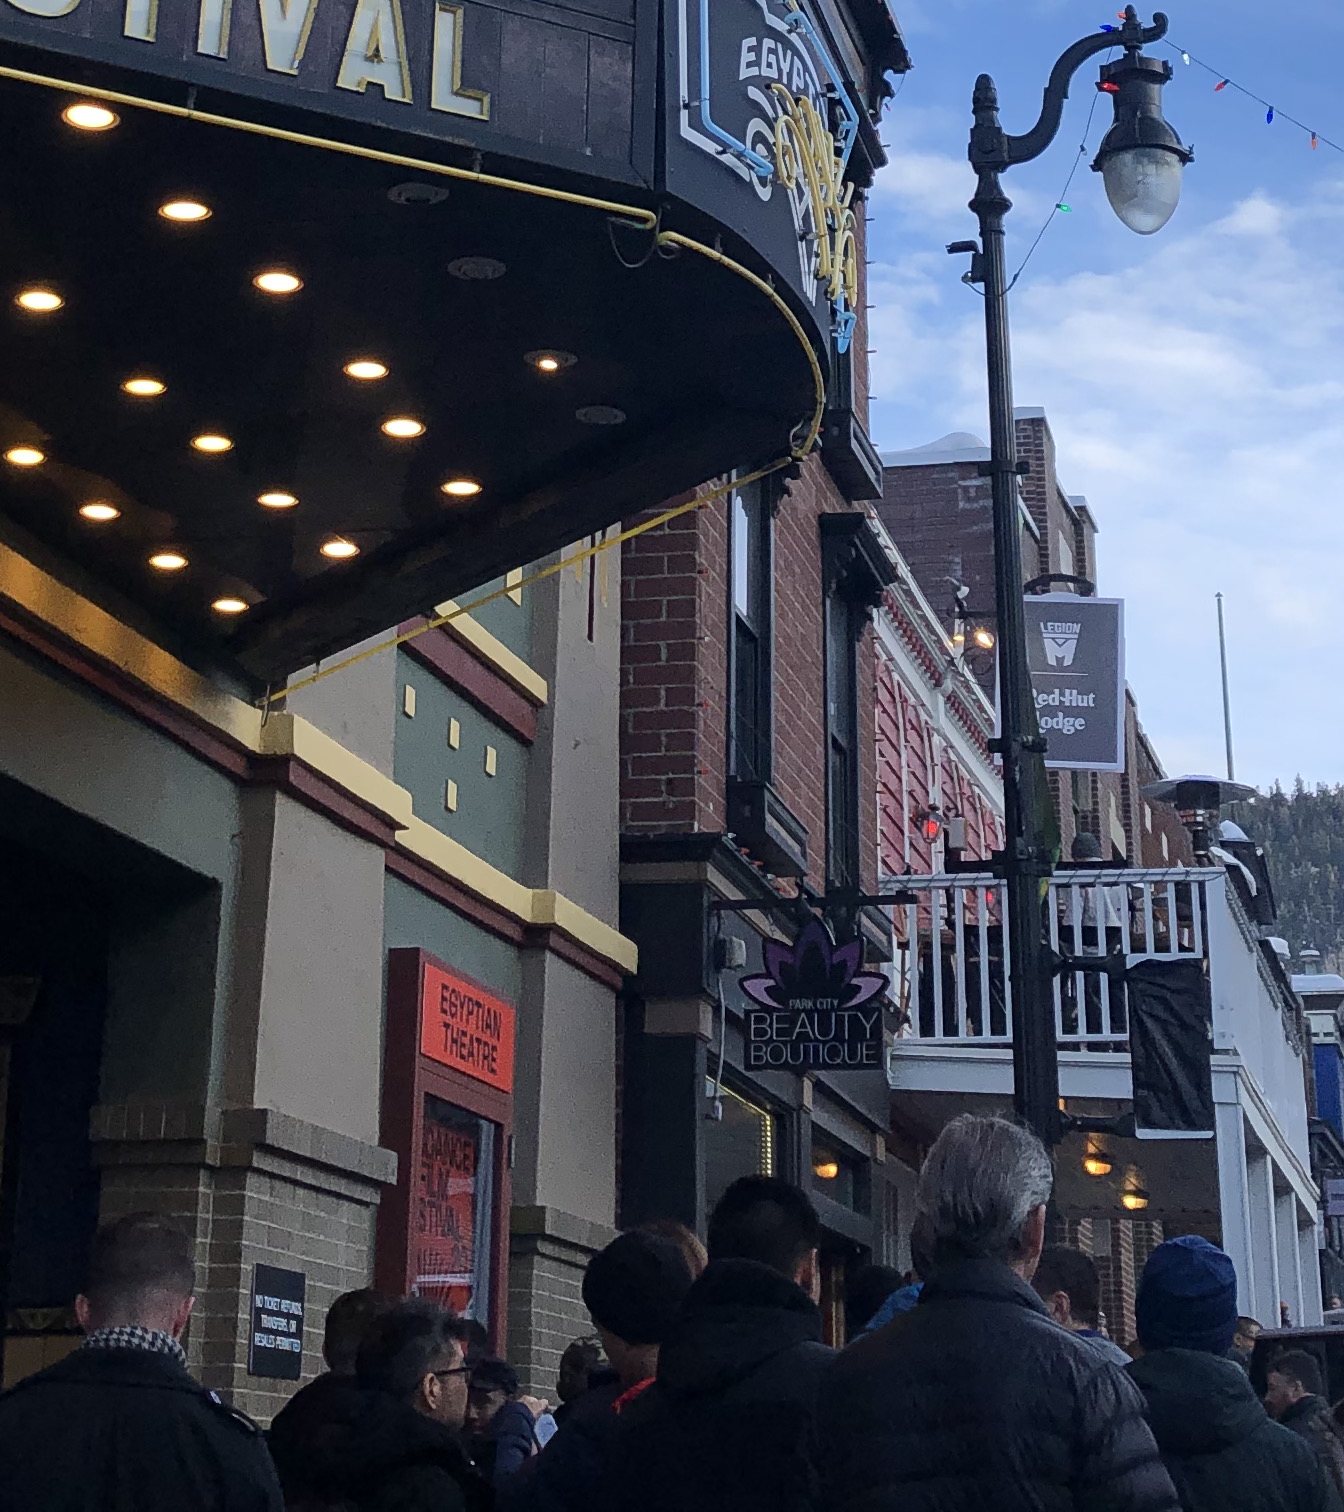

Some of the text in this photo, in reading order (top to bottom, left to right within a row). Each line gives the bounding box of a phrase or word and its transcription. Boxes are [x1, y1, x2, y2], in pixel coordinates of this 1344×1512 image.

[1040, 622, 1082, 634] LEGION
[440, 982, 502, 1042] EGYPTIAN
[789, 998, 840, 1010] PARK CITY
[750, 1011, 879, 1041] BEAUTY
[443, 1021, 498, 1076] THEATRE
[750, 1041, 878, 1065] BOUTIQUE
